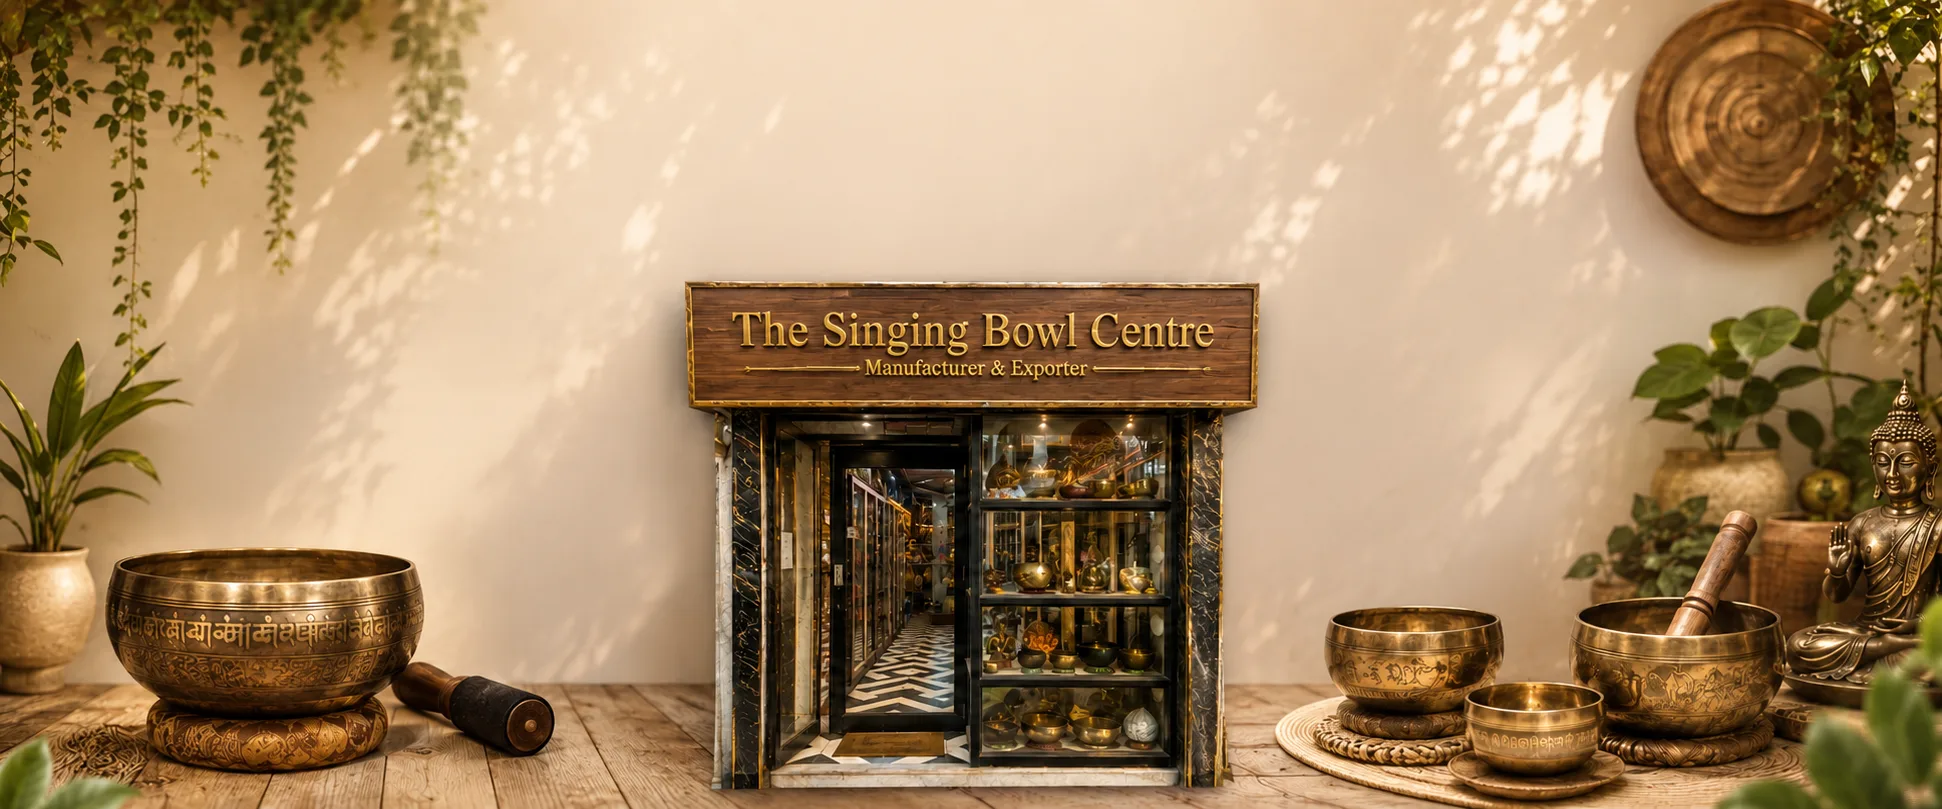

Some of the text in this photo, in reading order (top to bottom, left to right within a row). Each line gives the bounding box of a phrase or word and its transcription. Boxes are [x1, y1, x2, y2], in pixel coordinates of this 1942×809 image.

[732, 311, 1214, 356] The Singing Bowl Centre
[864, 359, 1088, 381] Manufacturer & Exporter
